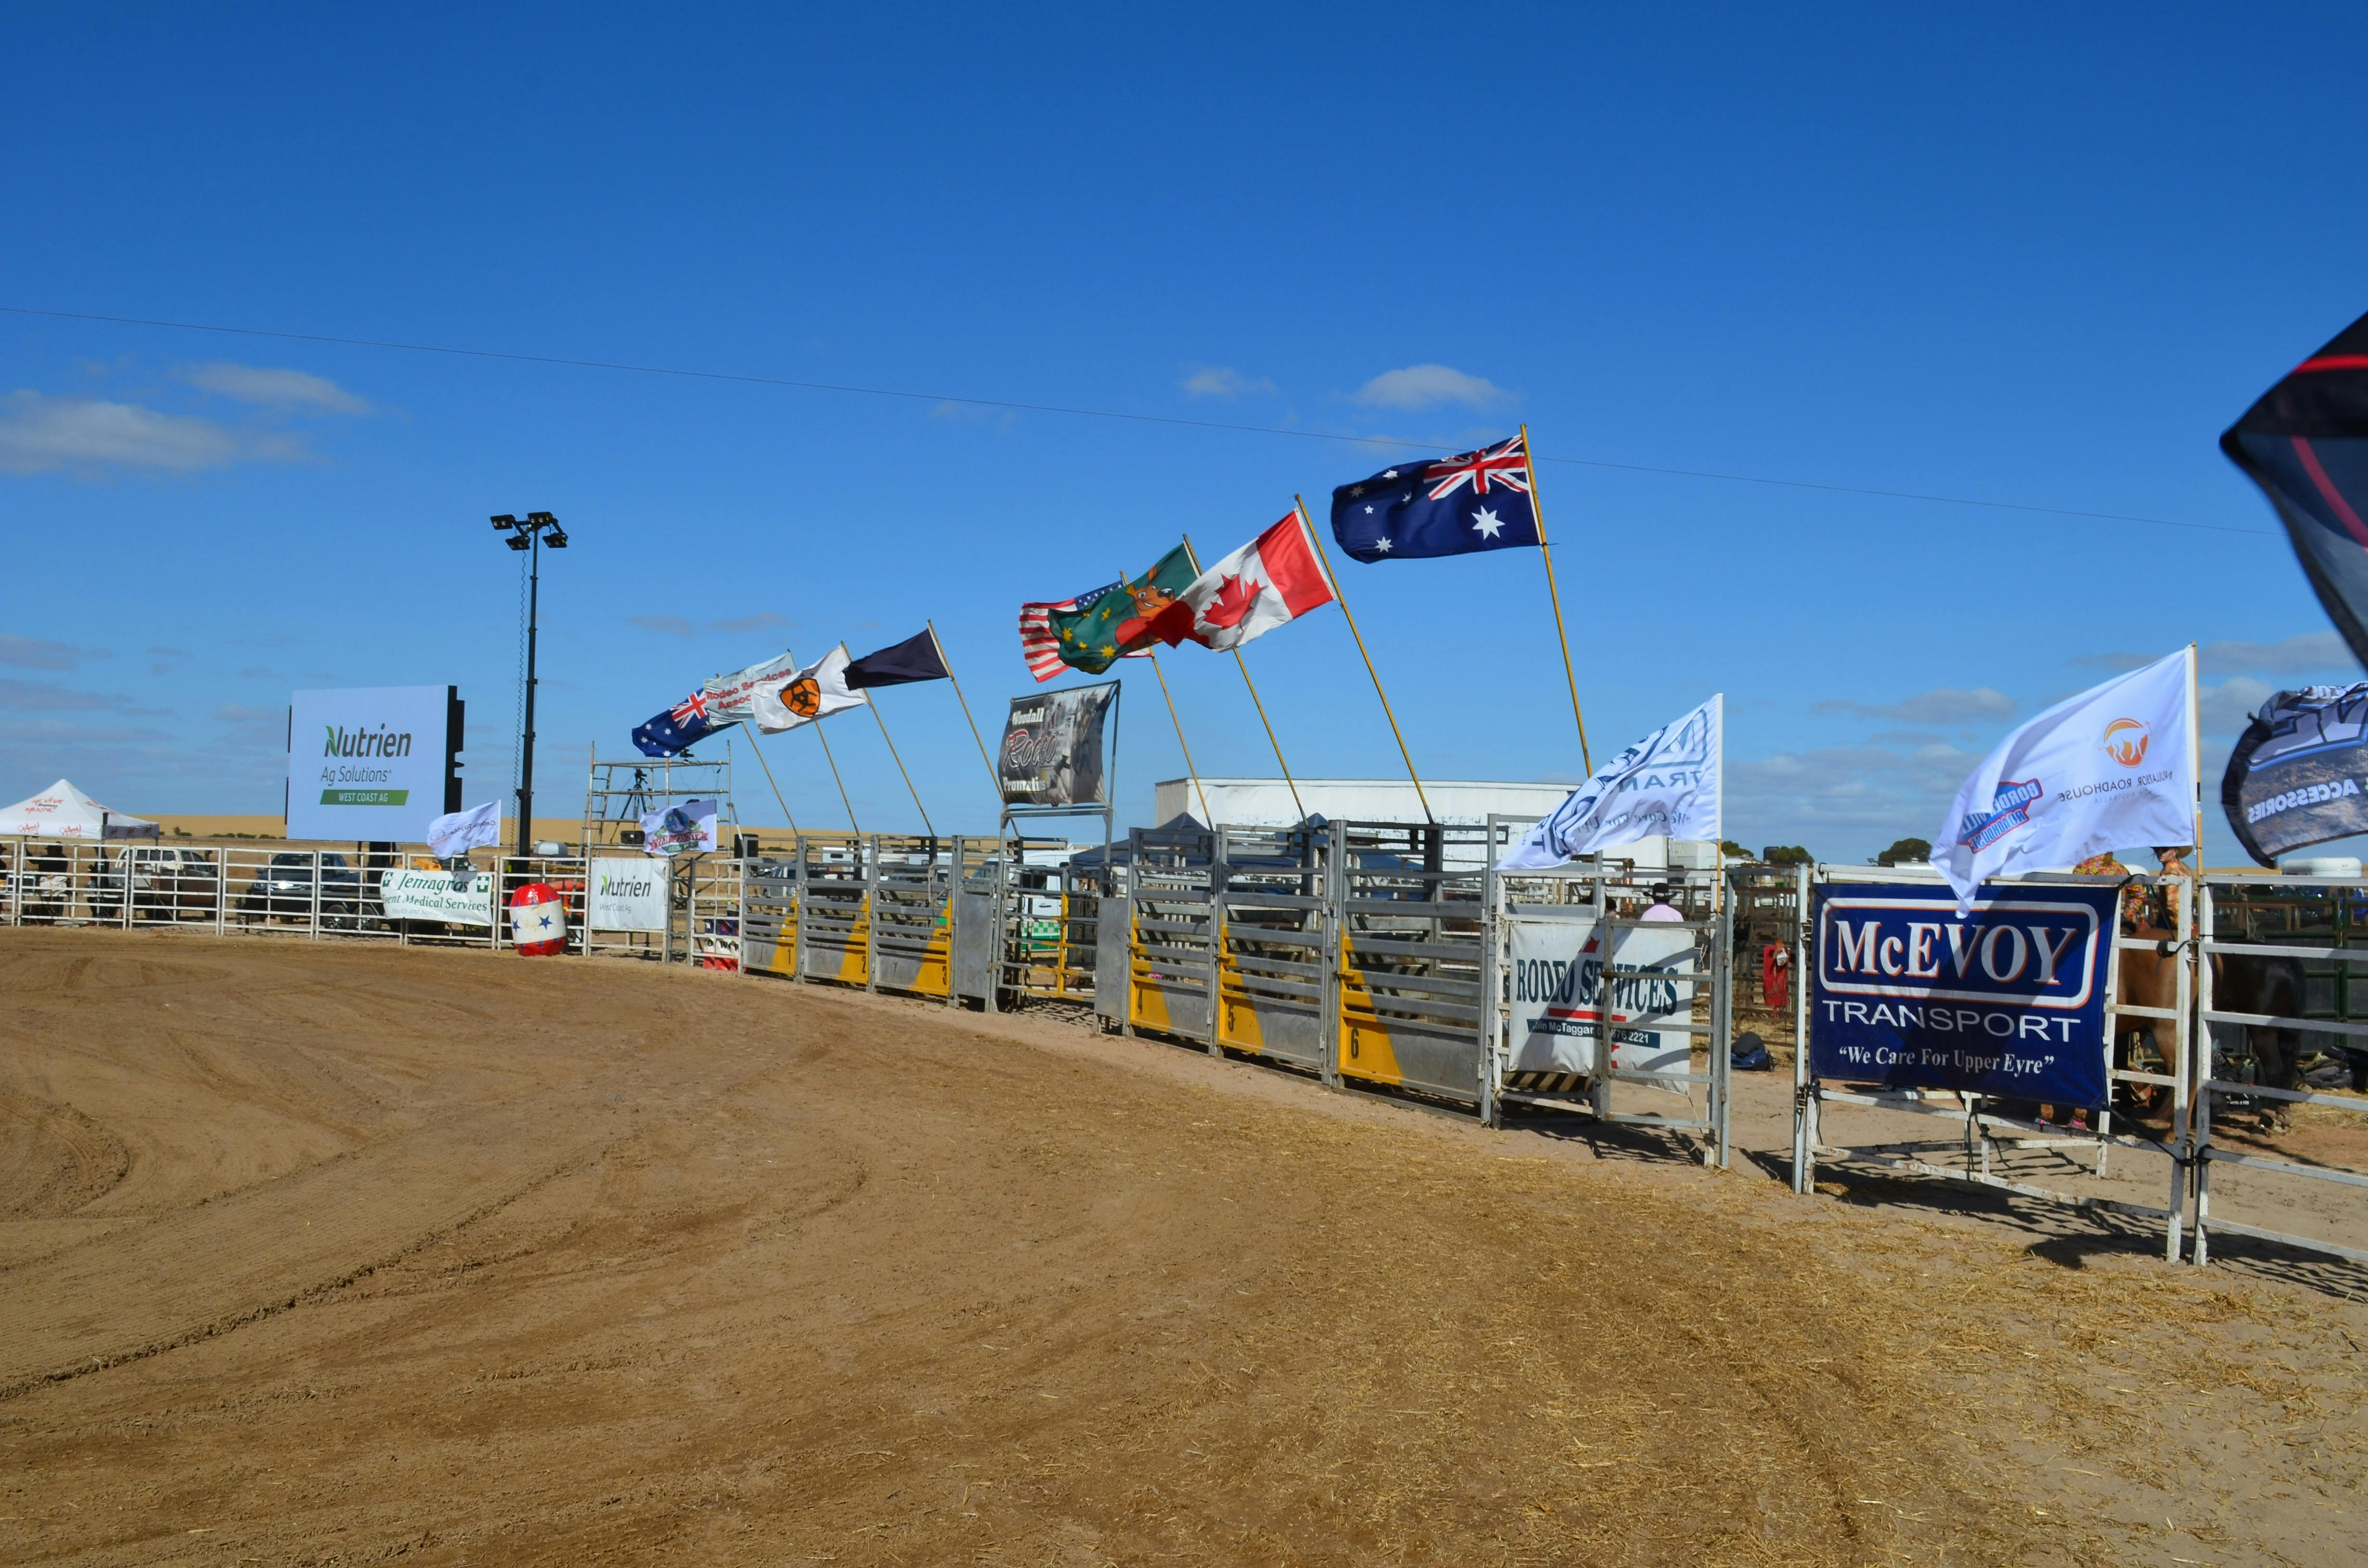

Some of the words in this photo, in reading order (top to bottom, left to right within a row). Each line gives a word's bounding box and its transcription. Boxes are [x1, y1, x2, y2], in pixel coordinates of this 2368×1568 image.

[706, 688, 739, 699] Rodeo
[718, 695, 751, 710] Assoc
[1011, 707, 1045, 725] Woodall
[324, 723, 412, 758] Nutrien
[1003, 728, 1057, 772] Rodeo
[321, 766, 336, 787] Ag
[338, 765, 389, 783] Solutions
[339, 793, 356, 802] WEST
[357, 793, 378, 802] COAST
[379, 793, 388, 802] AG
[600, 875, 651, 897] Nutrien
[403, 895, 444, 909] Medical
[445, 897, 488, 911] Services
[625, 904, 631, 914] Ag
[788, 948, 791, 965] 1
[1834, 920, 2078, 985] McEVOY
[862, 955, 866, 974] 2
[942, 965, 947, 985] 3
[1516, 959, 1576, 1004] RODEO
[1137, 988, 1143, 1014] 4
[1228, 1003, 1234, 1032] 5
[1822, 1000, 2081, 1043] TRANSPORT
[1351, 1027, 1359, 1060] 6
[1549, 1021, 1595, 1036] McTaggar
[1628, 1031, 1649, 1044] 2221
[1875, 1046, 1915, 1066] Care
[1922, 1048, 1949, 1066] For
[1954, 1050, 2000, 1074] Upper
